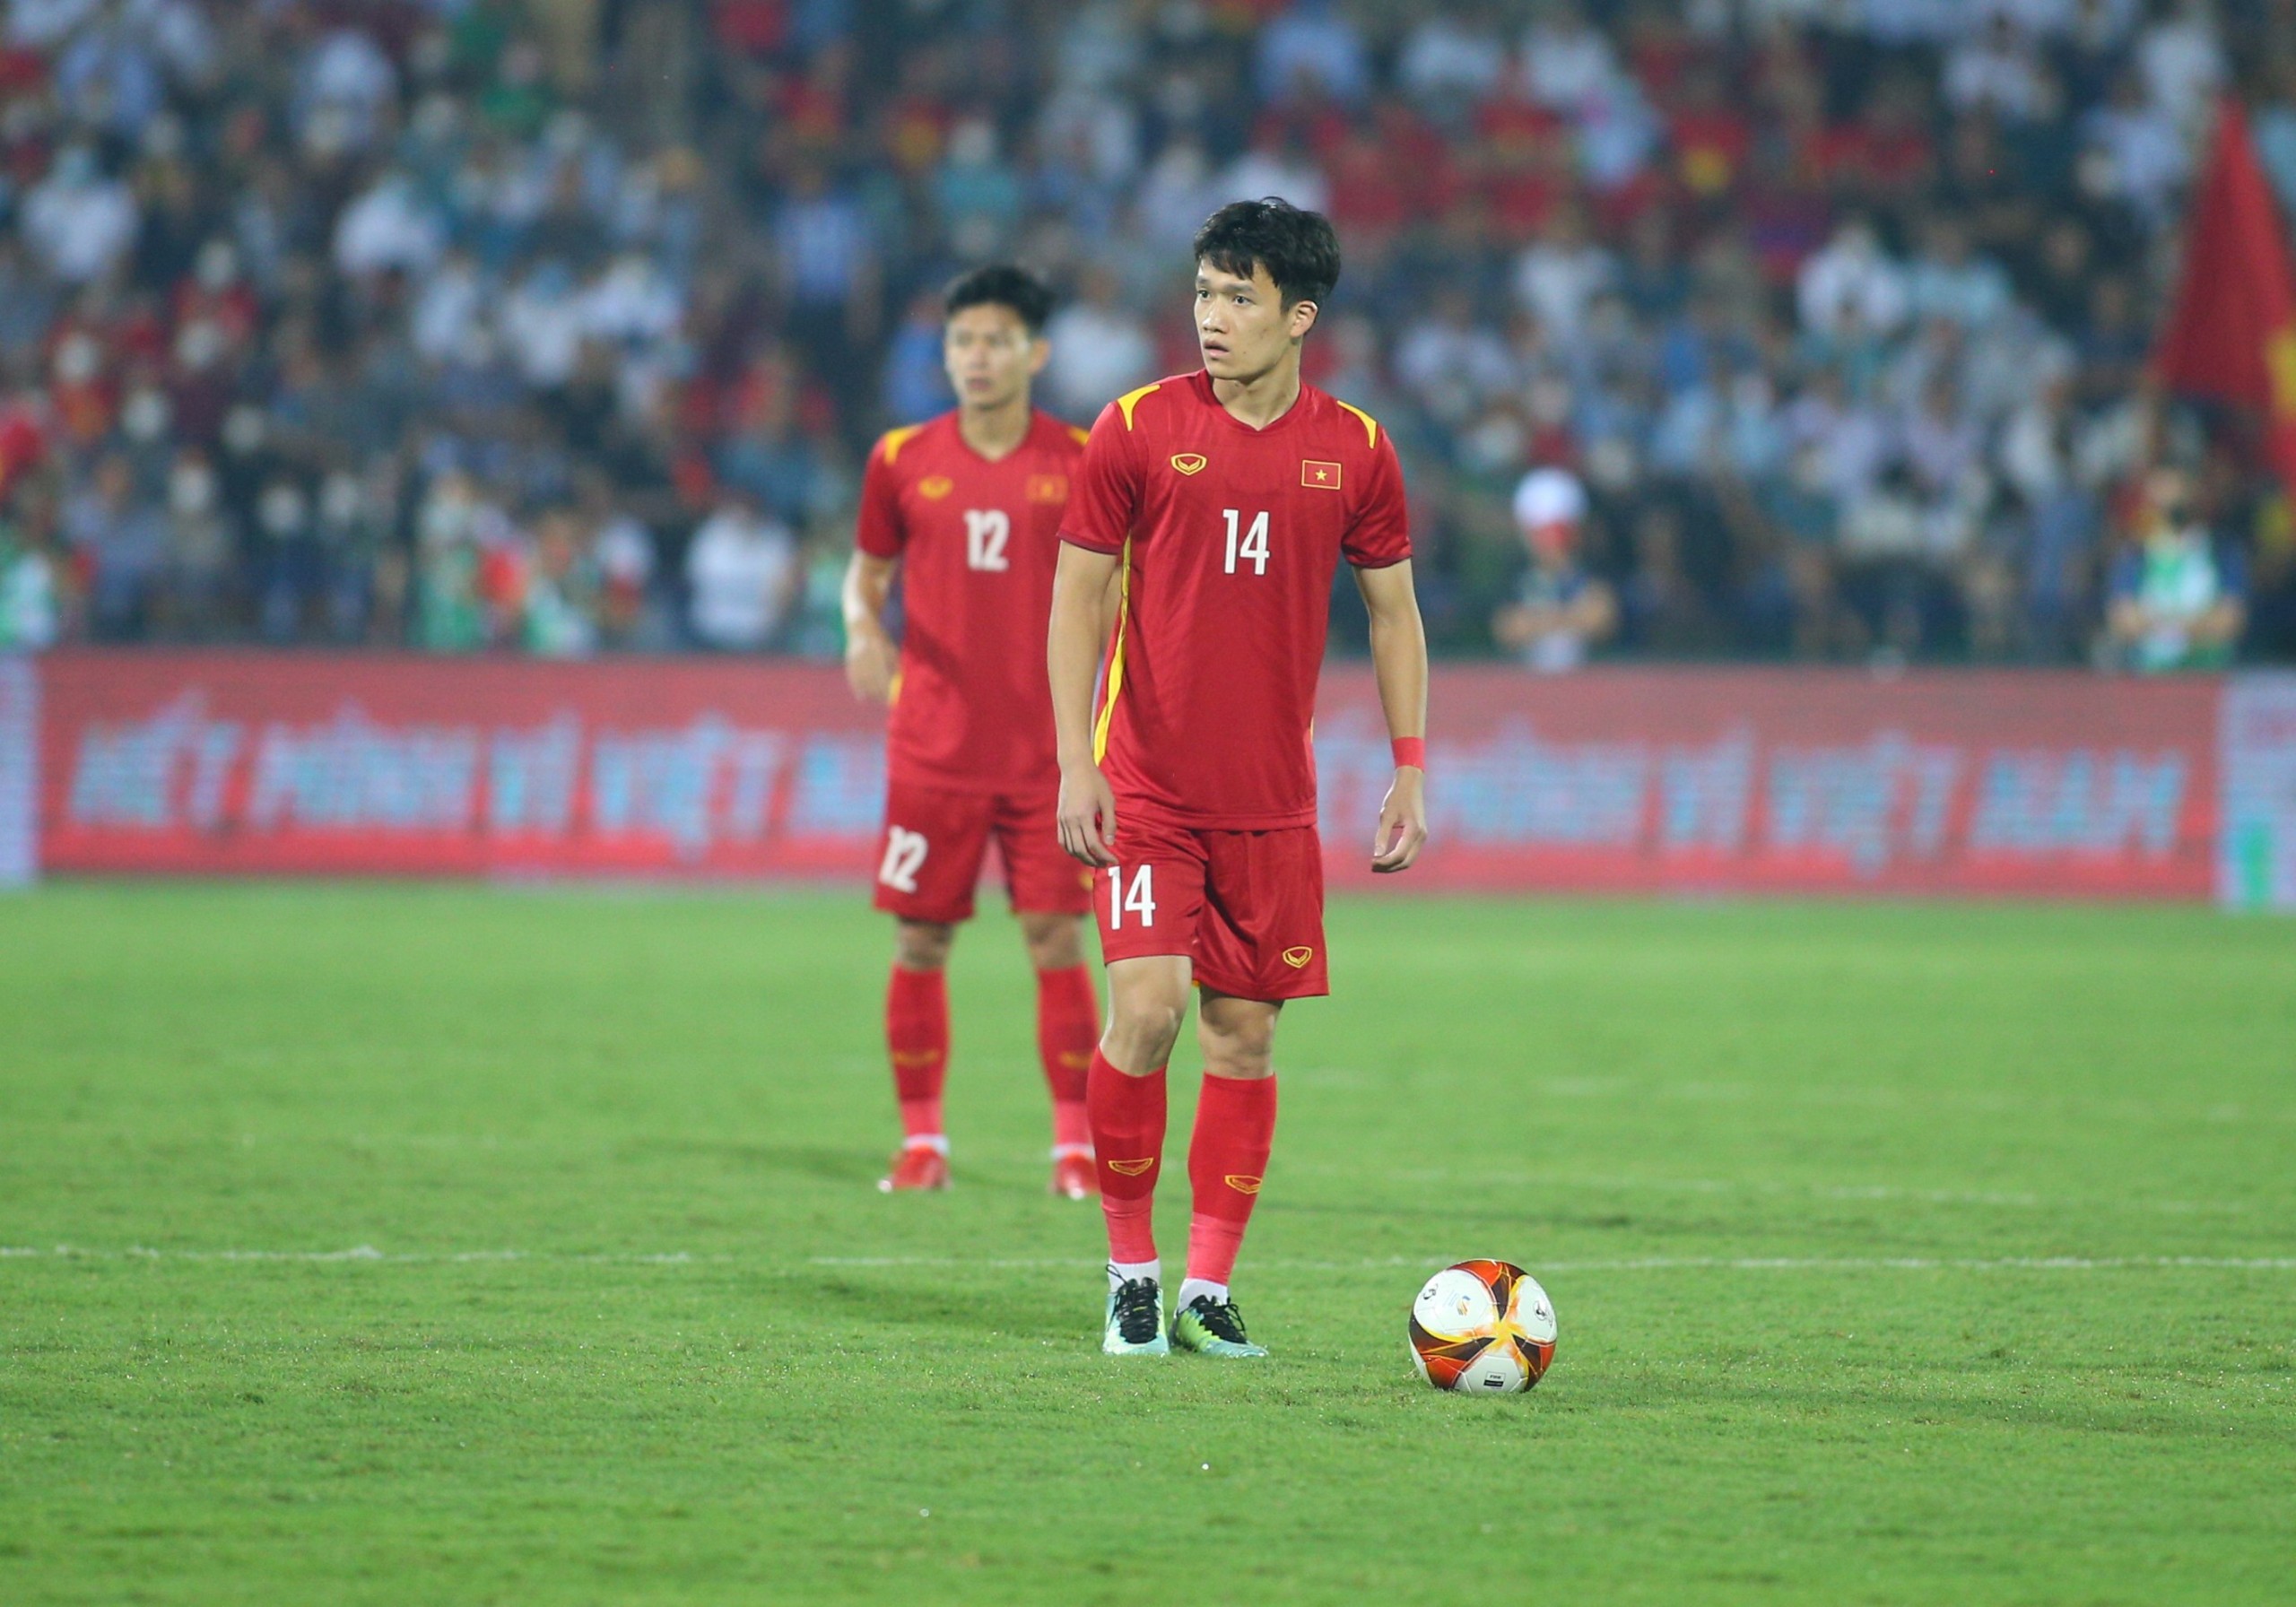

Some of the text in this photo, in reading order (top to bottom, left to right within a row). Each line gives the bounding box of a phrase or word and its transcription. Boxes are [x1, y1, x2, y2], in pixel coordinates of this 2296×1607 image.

[963, 508, 1010, 572] 12
[1222, 508, 1270, 576] 14
[879, 825, 928, 893] 12
[1108, 864, 1156, 930] 14
